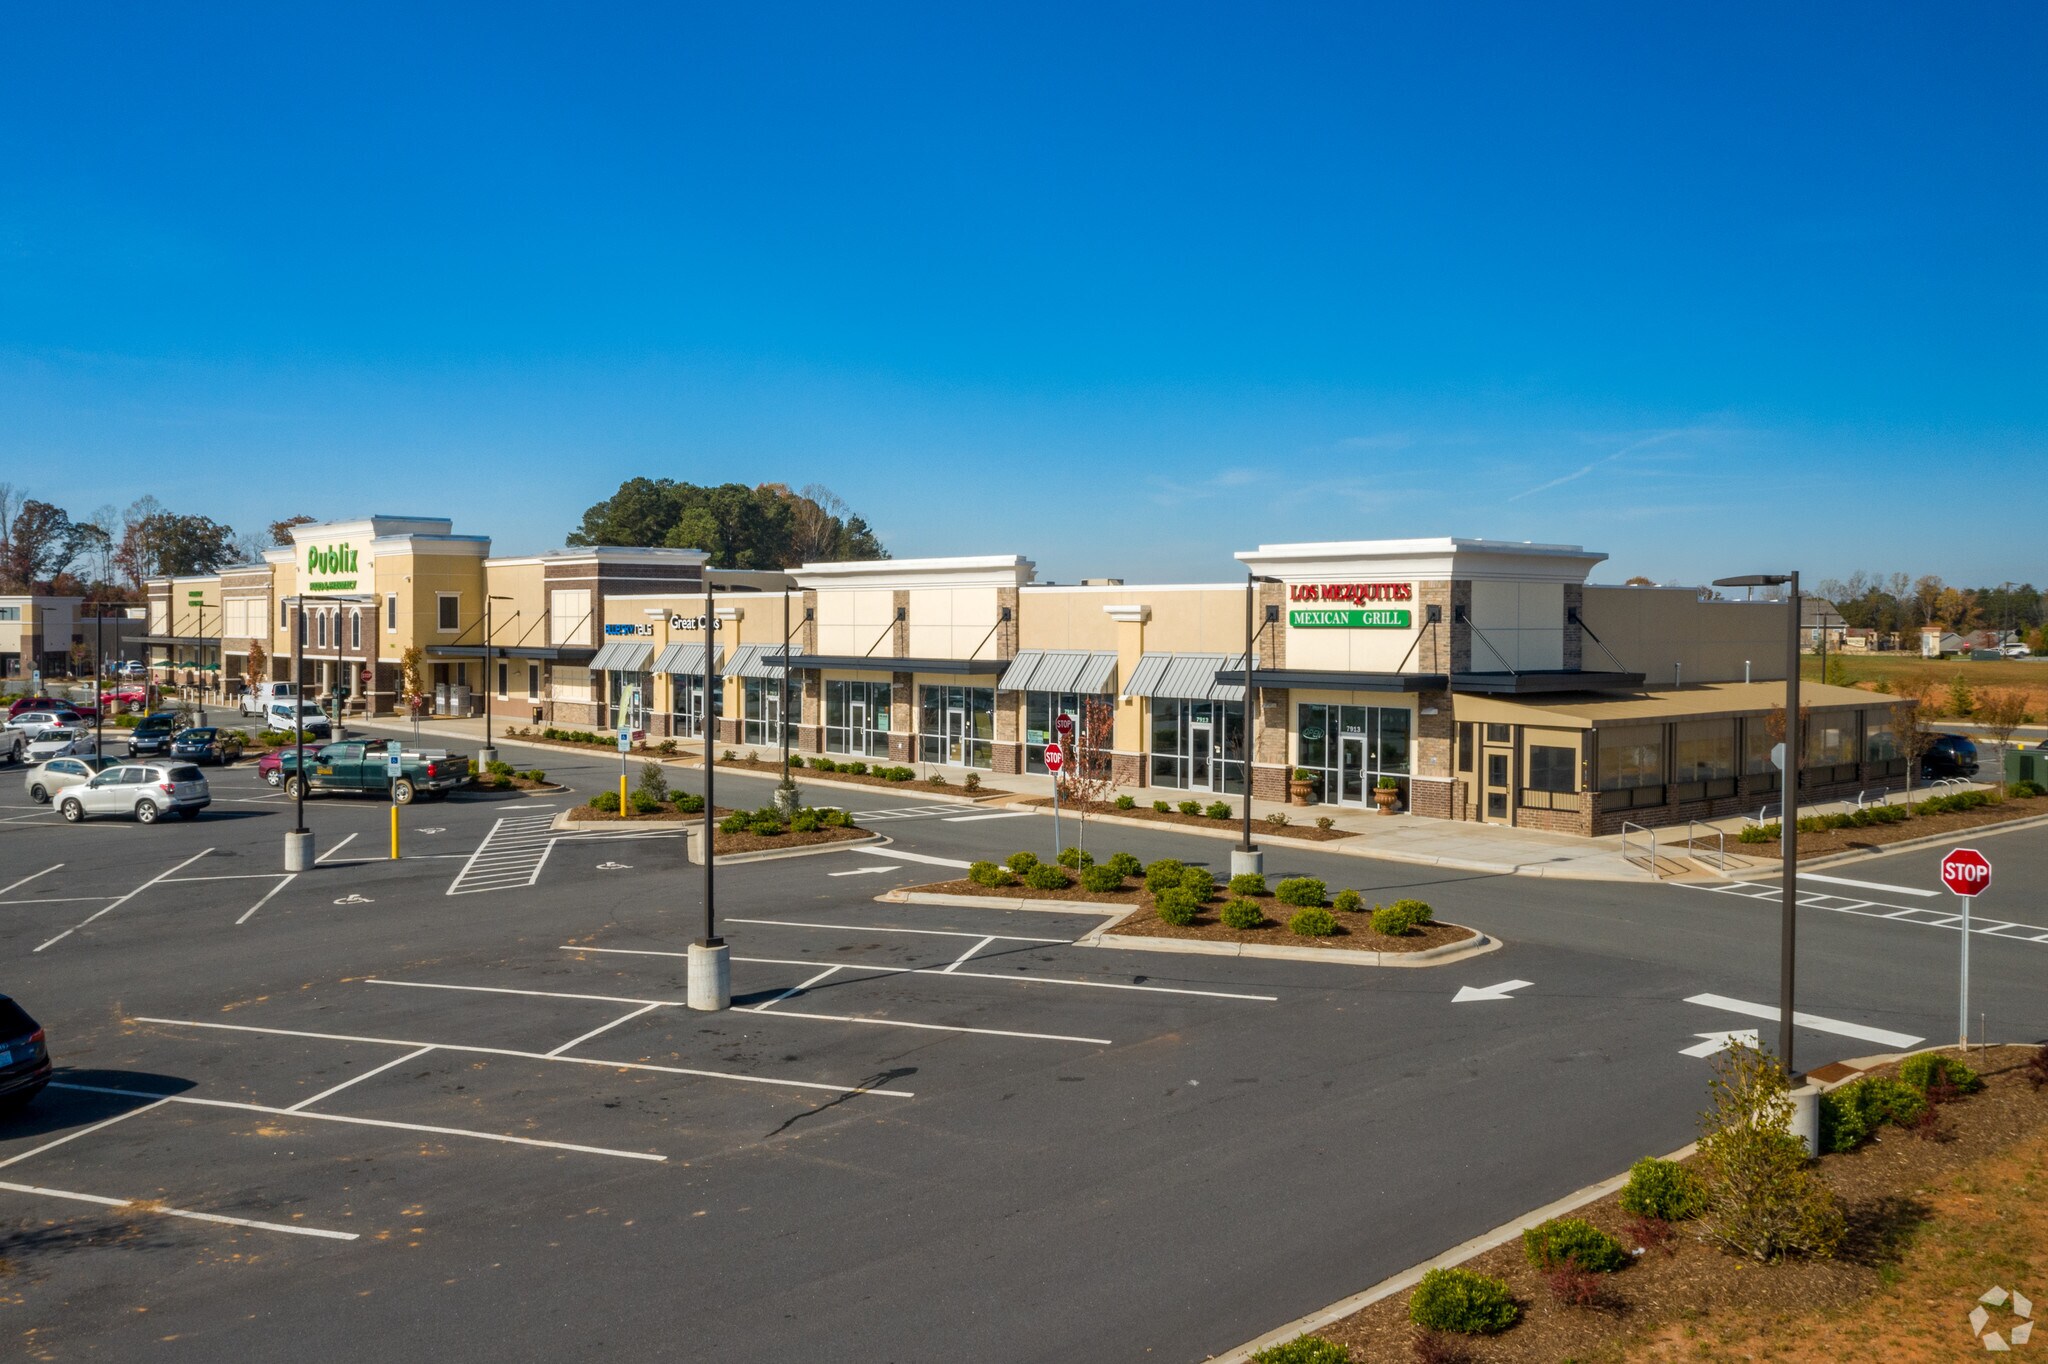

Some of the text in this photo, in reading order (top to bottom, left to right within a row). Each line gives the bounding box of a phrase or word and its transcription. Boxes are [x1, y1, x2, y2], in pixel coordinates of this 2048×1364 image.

[308, 542, 358, 575] Publix
[1290, 583, 1411, 607] LOS MEZQUITES
[670, 615, 696, 629] Great
[1294, 612, 1401, 625] MEXICAN GRILL
[1057, 719, 1071, 728] STOP
[1046, 752, 1062, 764] STOP
[1945, 862, 1988, 882] STOP
